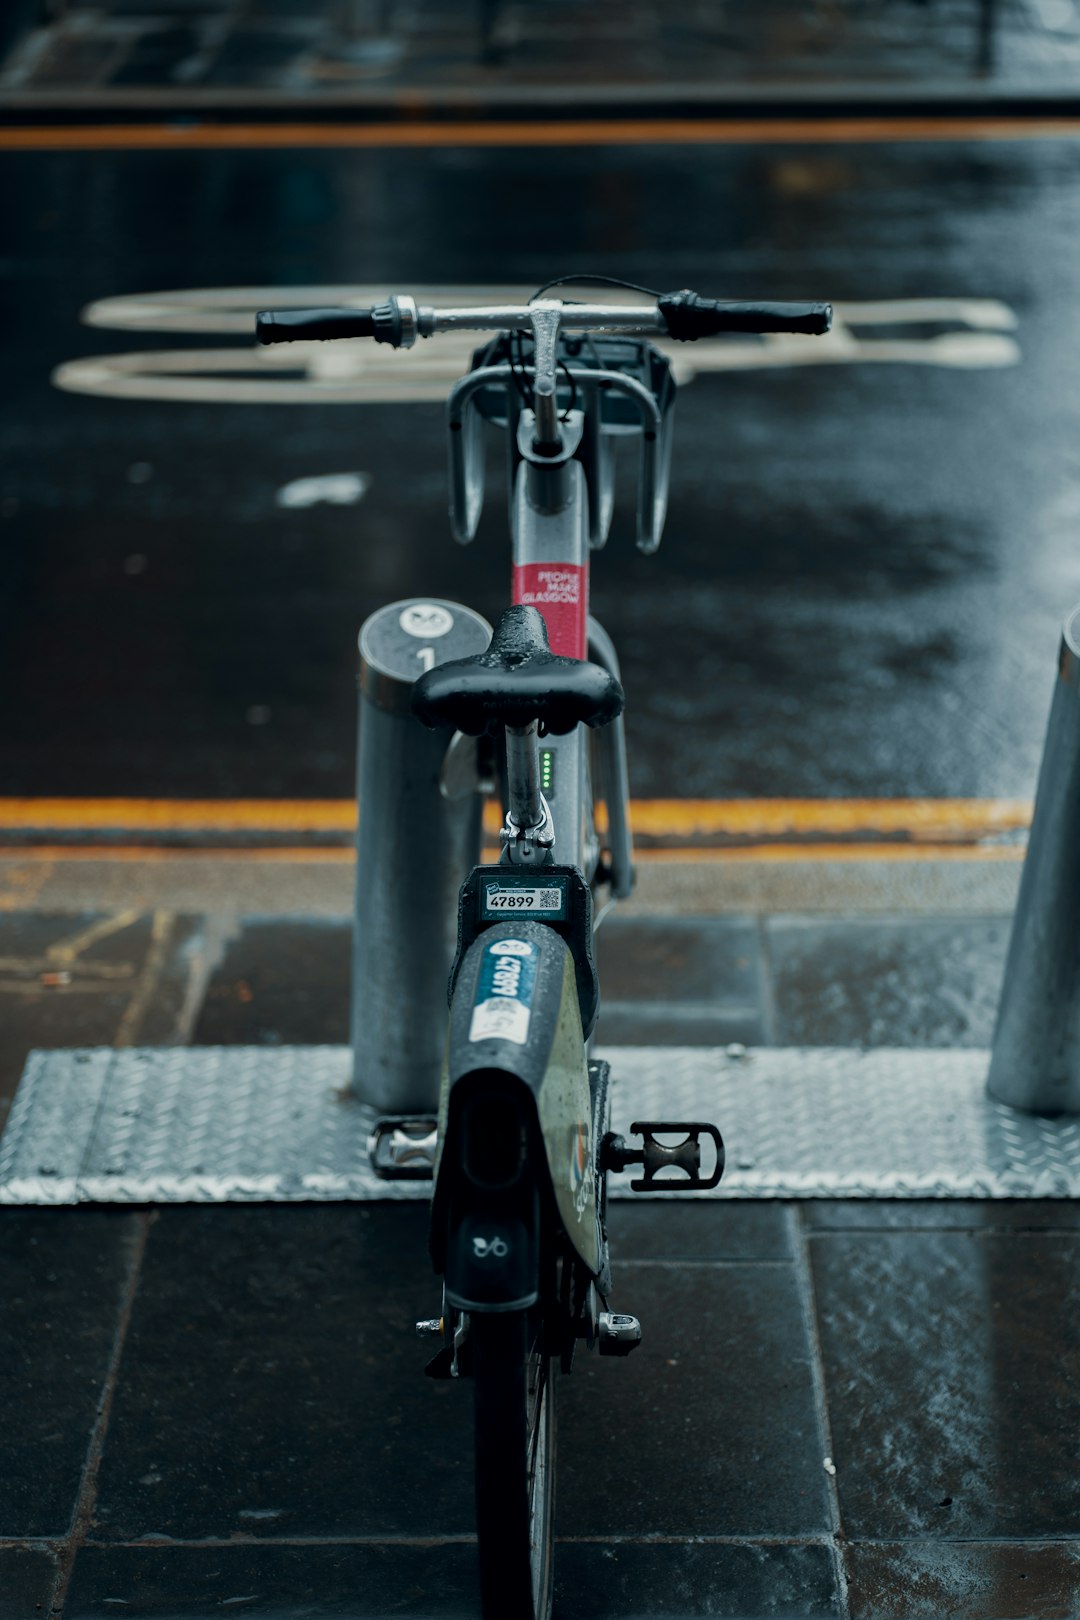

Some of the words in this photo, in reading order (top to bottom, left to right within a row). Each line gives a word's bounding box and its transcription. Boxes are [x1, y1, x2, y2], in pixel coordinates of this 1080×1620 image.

[521, 591, 578, 604] GLASGOW
[416, 647, 434, 672] 1
[490, 896, 534, 908] 47899
[491, 956, 521, 996] 47899
